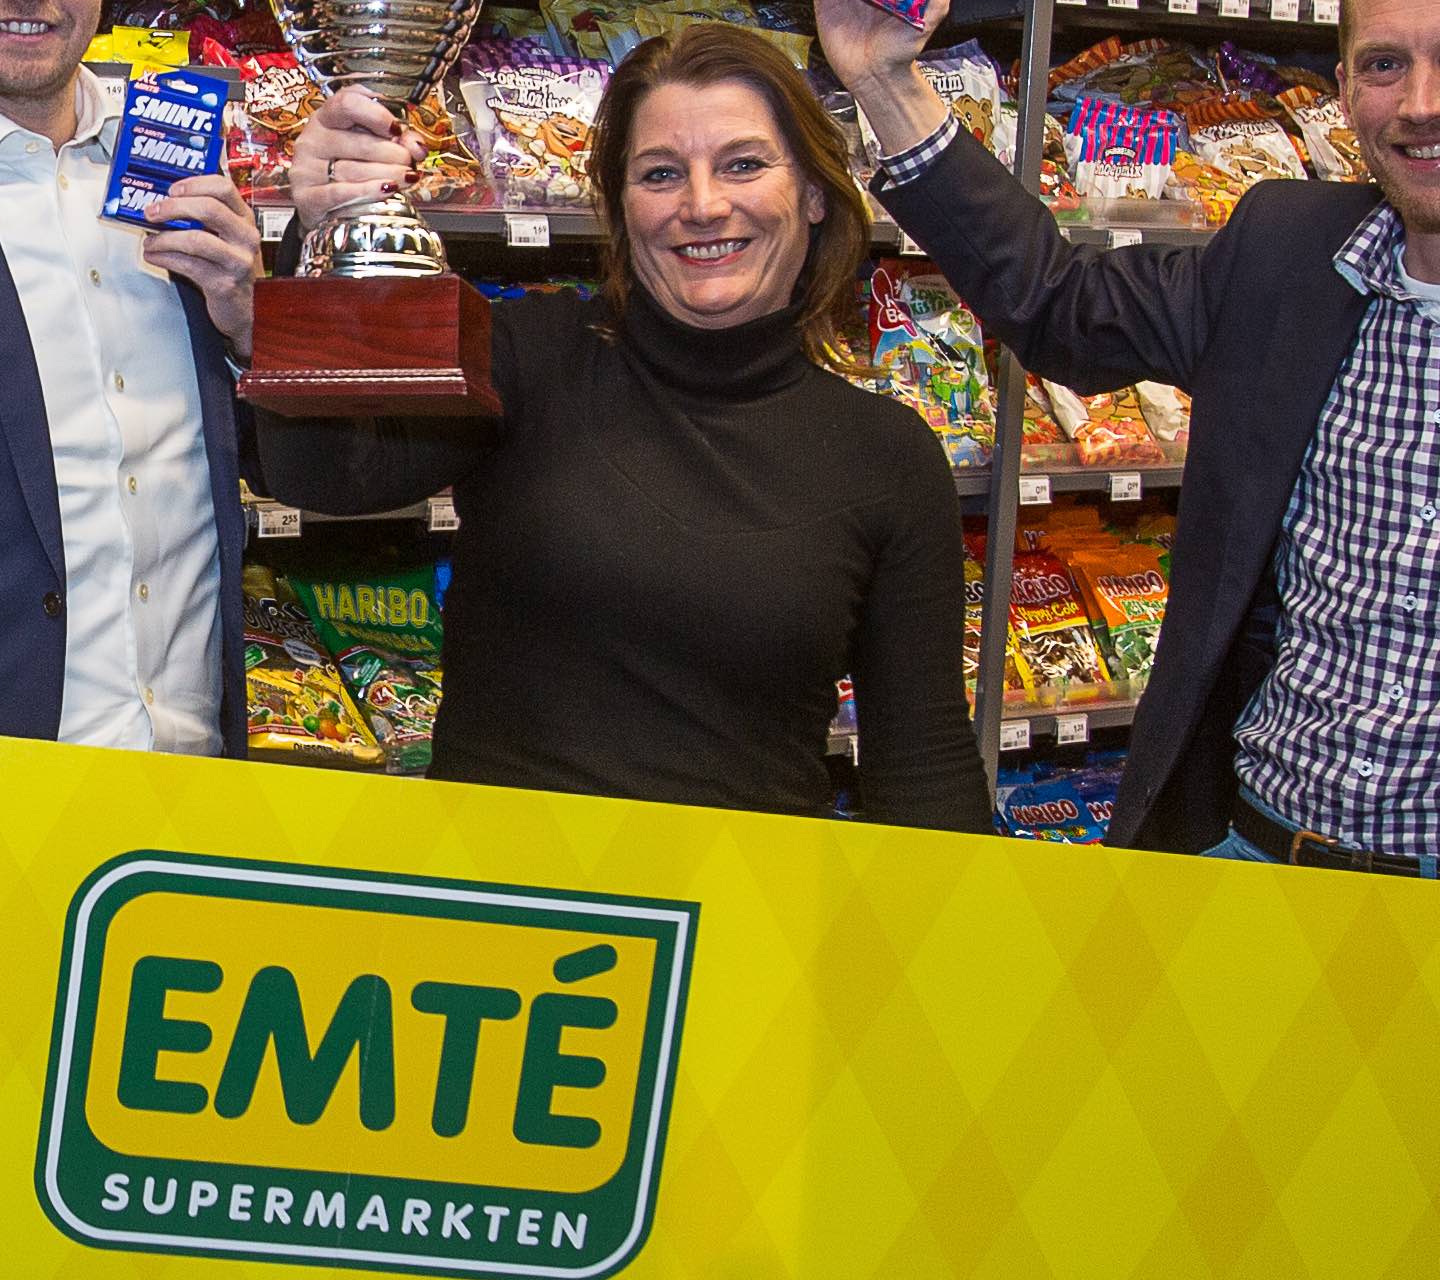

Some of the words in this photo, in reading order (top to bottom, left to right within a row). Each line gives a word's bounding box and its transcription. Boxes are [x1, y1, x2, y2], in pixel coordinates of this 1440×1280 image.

[128, 95, 215, 132] SMINT
[129, 135, 208, 170] SMINT
[312, 582, 429, 627] HARIBO
[117, 943, 618, 1149] EMTÉ
[100, 1172, 589, 1250] SUPERMARKTEN
